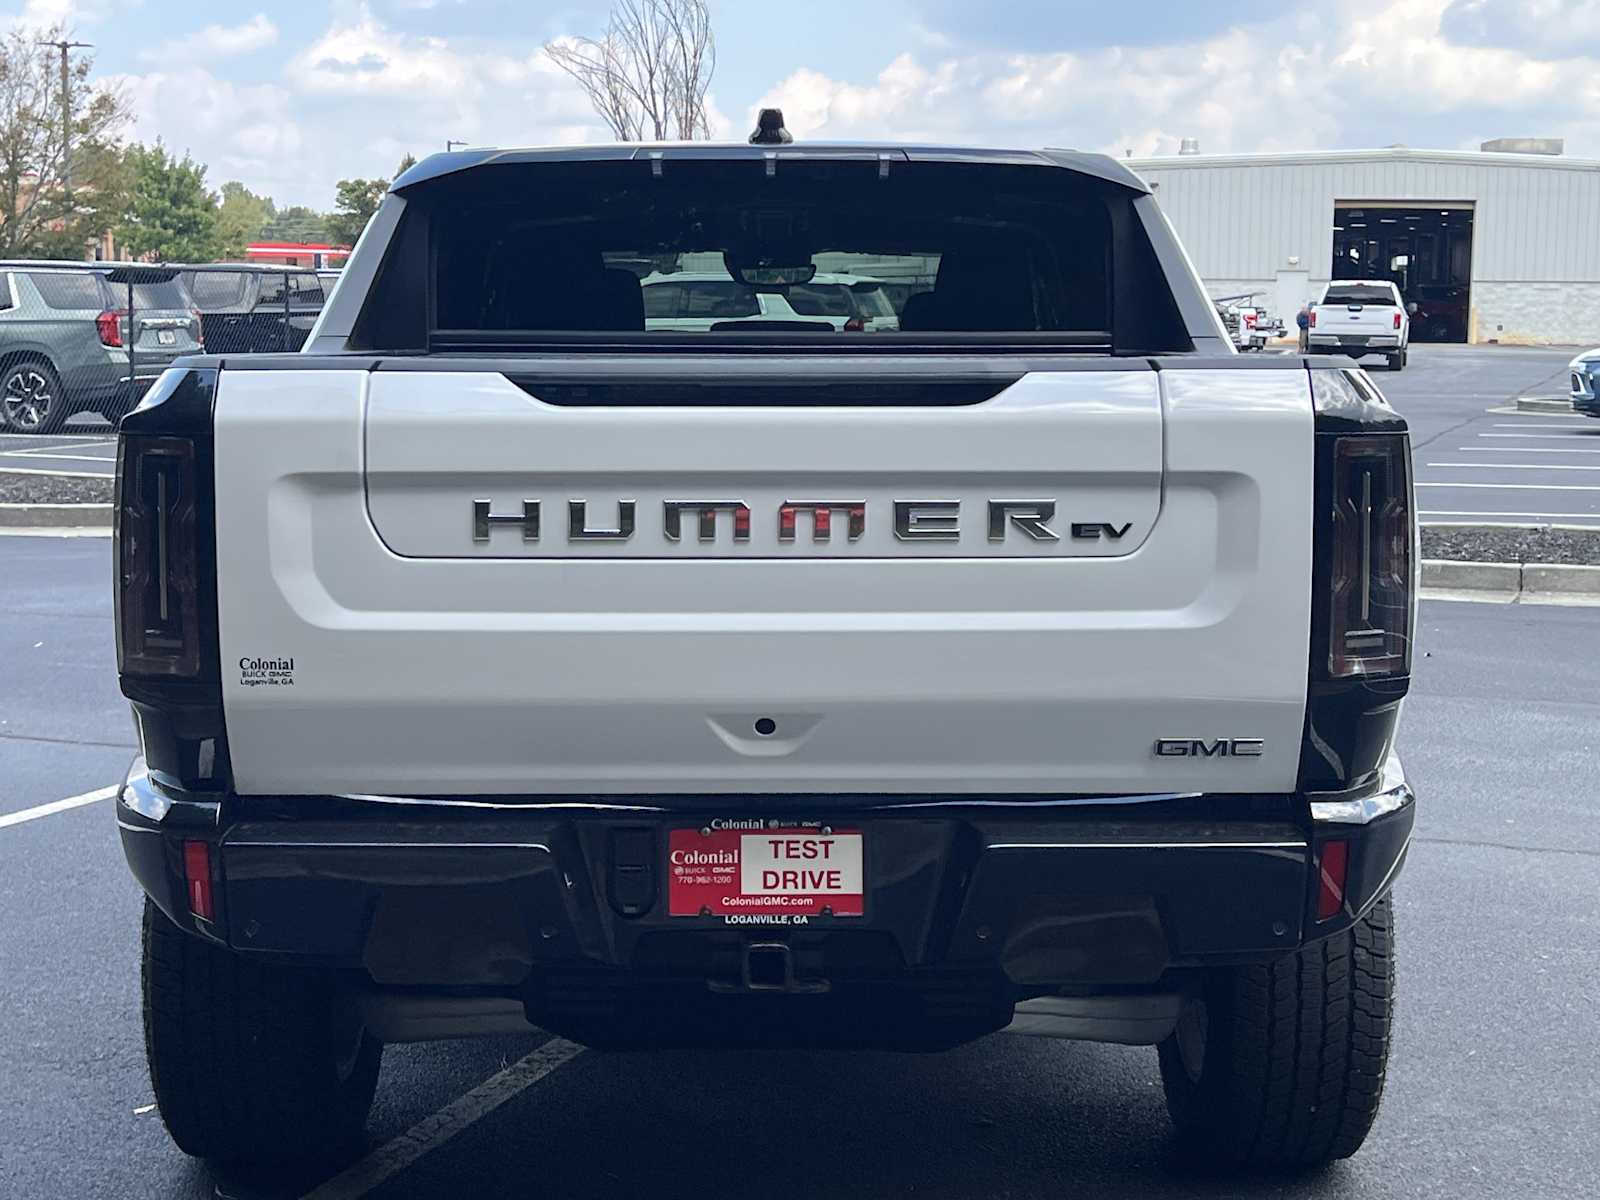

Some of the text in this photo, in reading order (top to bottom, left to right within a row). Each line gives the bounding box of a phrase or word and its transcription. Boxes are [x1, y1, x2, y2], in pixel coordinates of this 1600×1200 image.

[473, 498, 1133, 543] HUMMER EV
[239, 657, 294, 670] Colonial
[281, 678, 294, 686] GA
[1154, 737, 1264, 757] GMC
[711, 818, 764, 830] Colonial
[768, 840, 835, 859] TEST
[670, 849, 739, 865] Colonial
[763, 870, 842, 890] DRIVE
[721, 896, 814, 906] ColonialGMC.com
[724, 915, 809, 925] LOGANVILLE, GA
